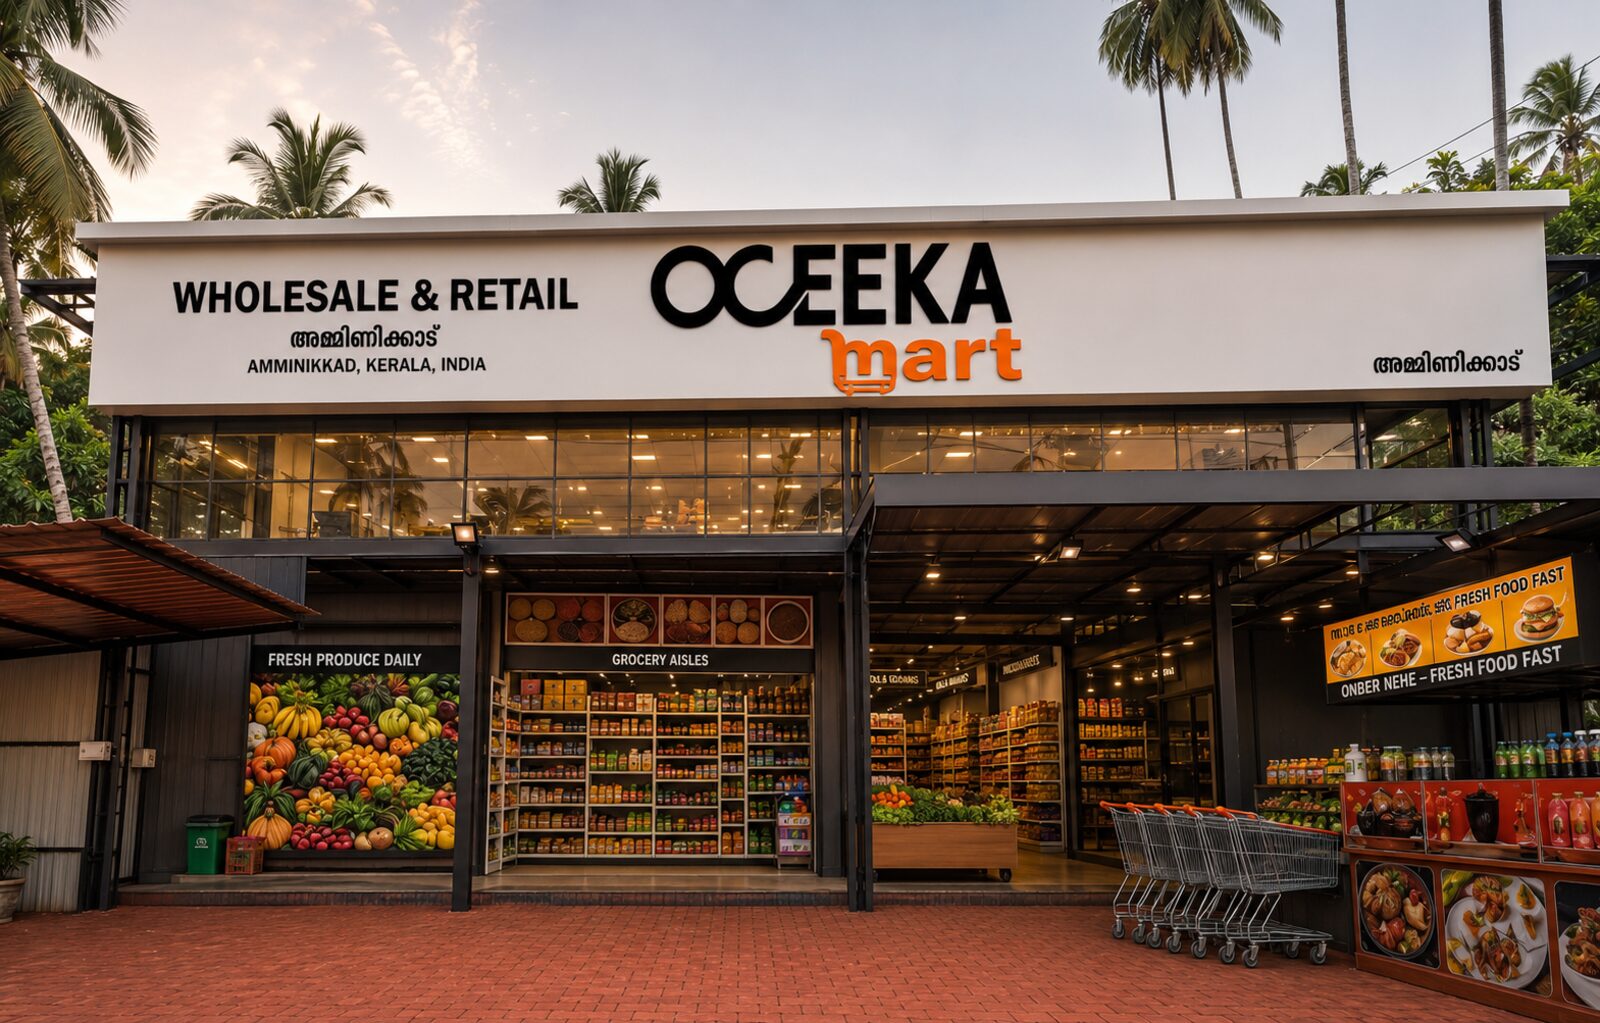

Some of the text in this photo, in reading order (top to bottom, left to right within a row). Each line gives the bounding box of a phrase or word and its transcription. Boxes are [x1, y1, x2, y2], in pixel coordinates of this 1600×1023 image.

[173, 277, 578, 313] WHOLESALE & RETAIL
[650, 242, 1012, 329] OCEEKA
[290, 324, 441, 348] അമ്മിണിക്കാട്
[247, 357, 486, 374] AMMINIKKAD, KERALA, INDIA
[820, 328, 1022, 396] mart
[1373, 349, 1524, 373] അമ്മിണിക്കാട്
[1454, 566, 1564, 609] FRESH FOOD FAST
[268, 653, 422, 666] FRESH PRODUCE DAILY
[612, 654, 709, 666] GROCERY AISLES
[1341, 679, 1380, 698] ONBER
[1384, 672, 1417, 691] NEHE
[1430, 661, 1474, 683] FRESH
[1477, 654, 1518, 675] FOOD
[1522, 645, 1562, 667] FAST
